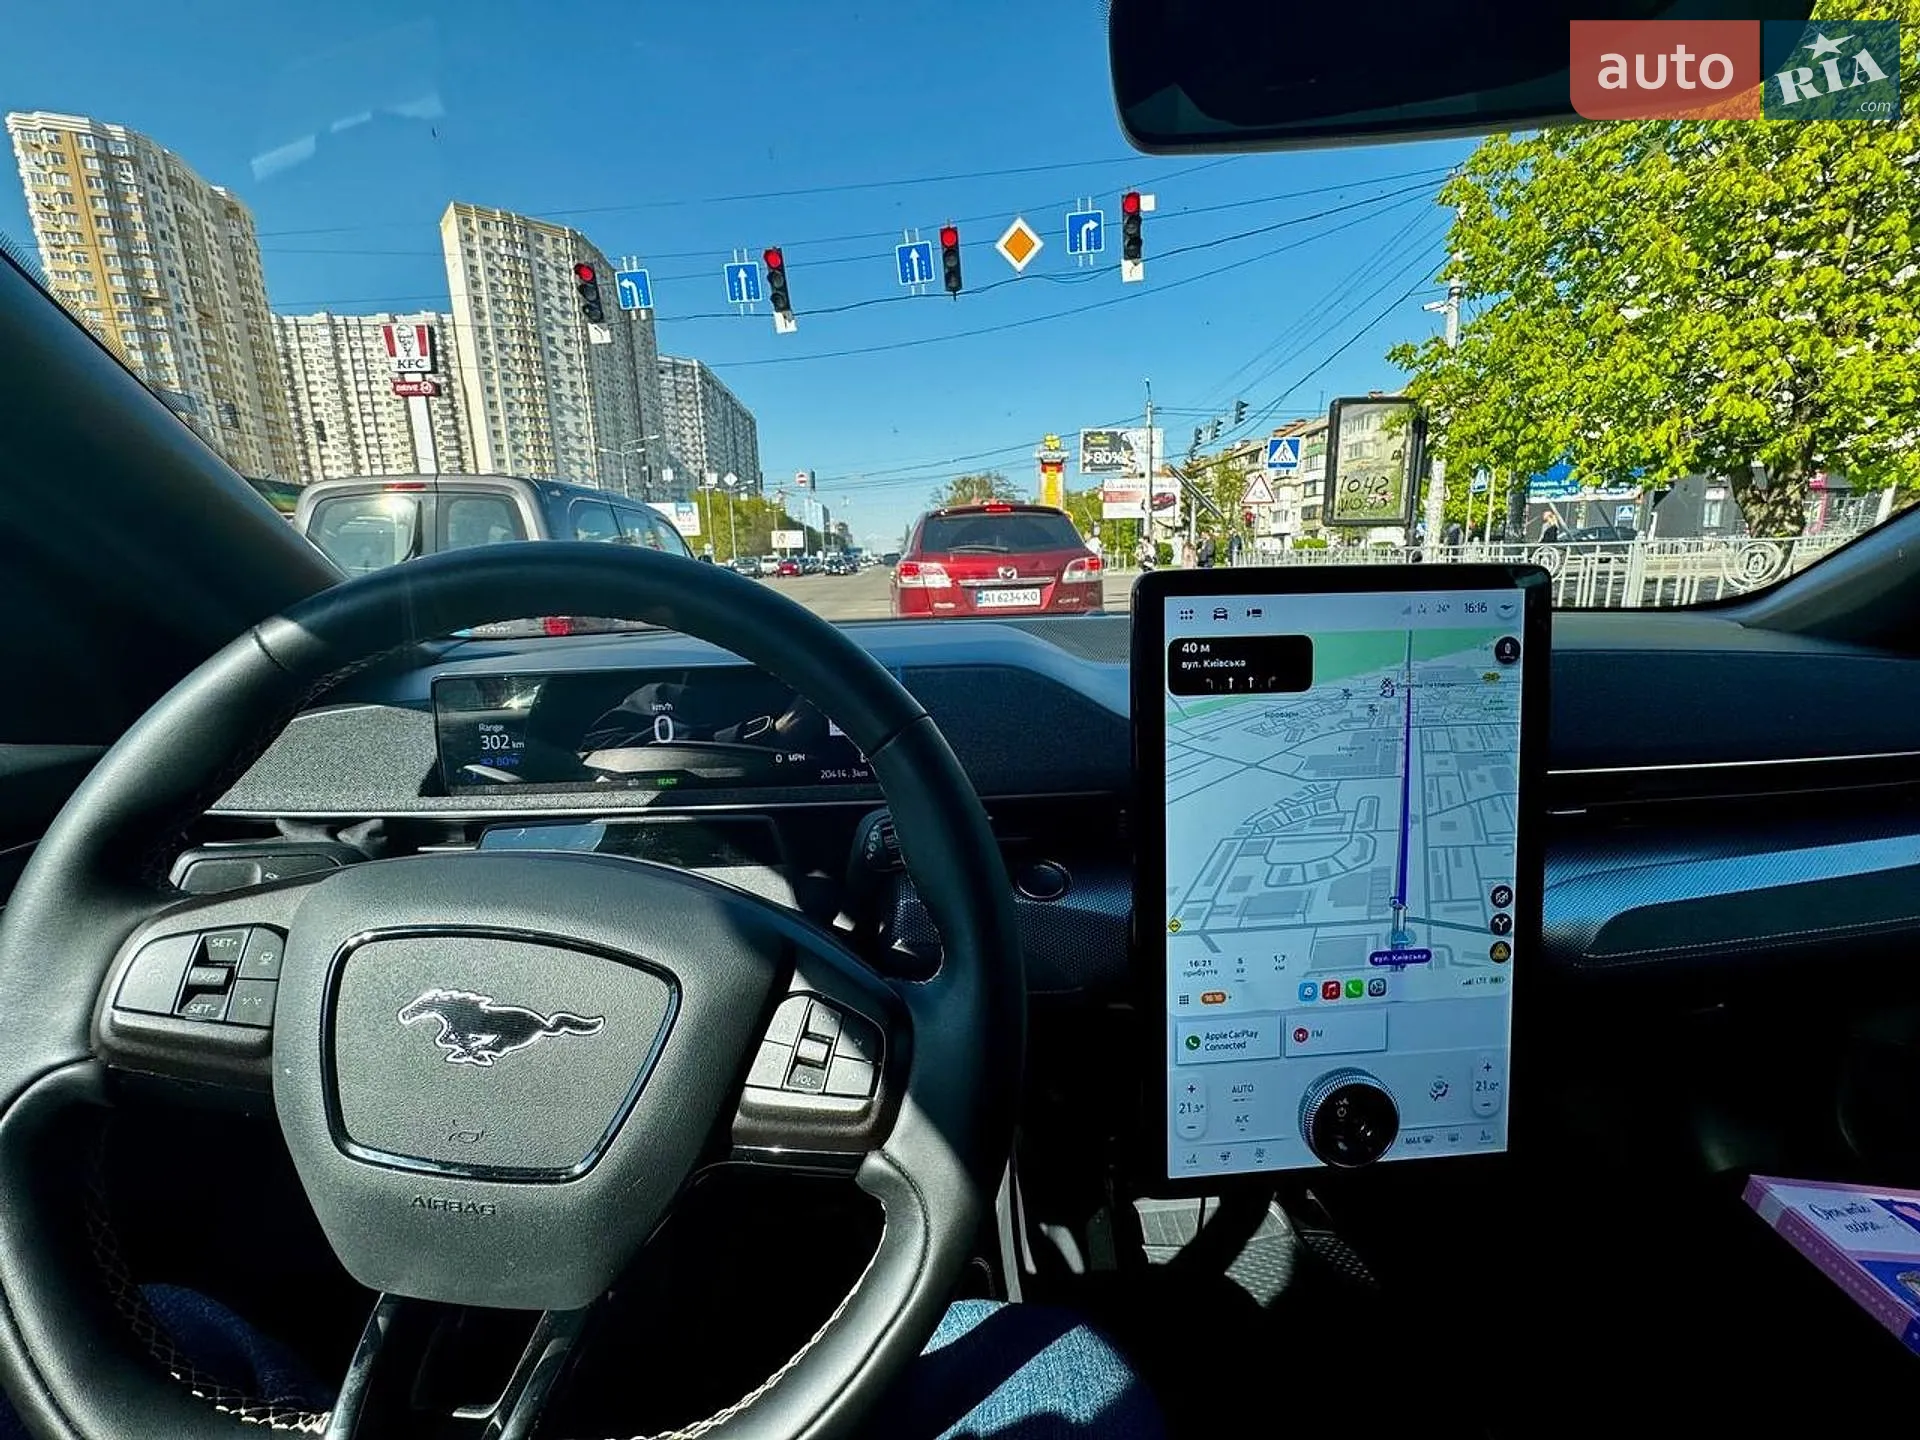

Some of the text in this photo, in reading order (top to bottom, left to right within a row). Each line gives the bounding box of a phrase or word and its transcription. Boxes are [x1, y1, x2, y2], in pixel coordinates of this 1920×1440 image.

[397, 359, 424, 369] KFC
[1465, 602, 1488, 613] 16:16
[1182, 642, 1198, 653] 40
[1182, 658, 1246, 670] вул. Київська
[479, 723, 504, 733] Range
[654, 715, 674, 743] 0
[480, 735, 525, 750] 302 km
[212, 938, 237, 947] SET+
[1205, 1029, 1259, 1041] Apple CarPlay
[1205, 1041, 1247, 1051] Connected
[1231, 1084, 1254, 1093] AUTO
[411, 1196, 496, 1215] AIRBAG
